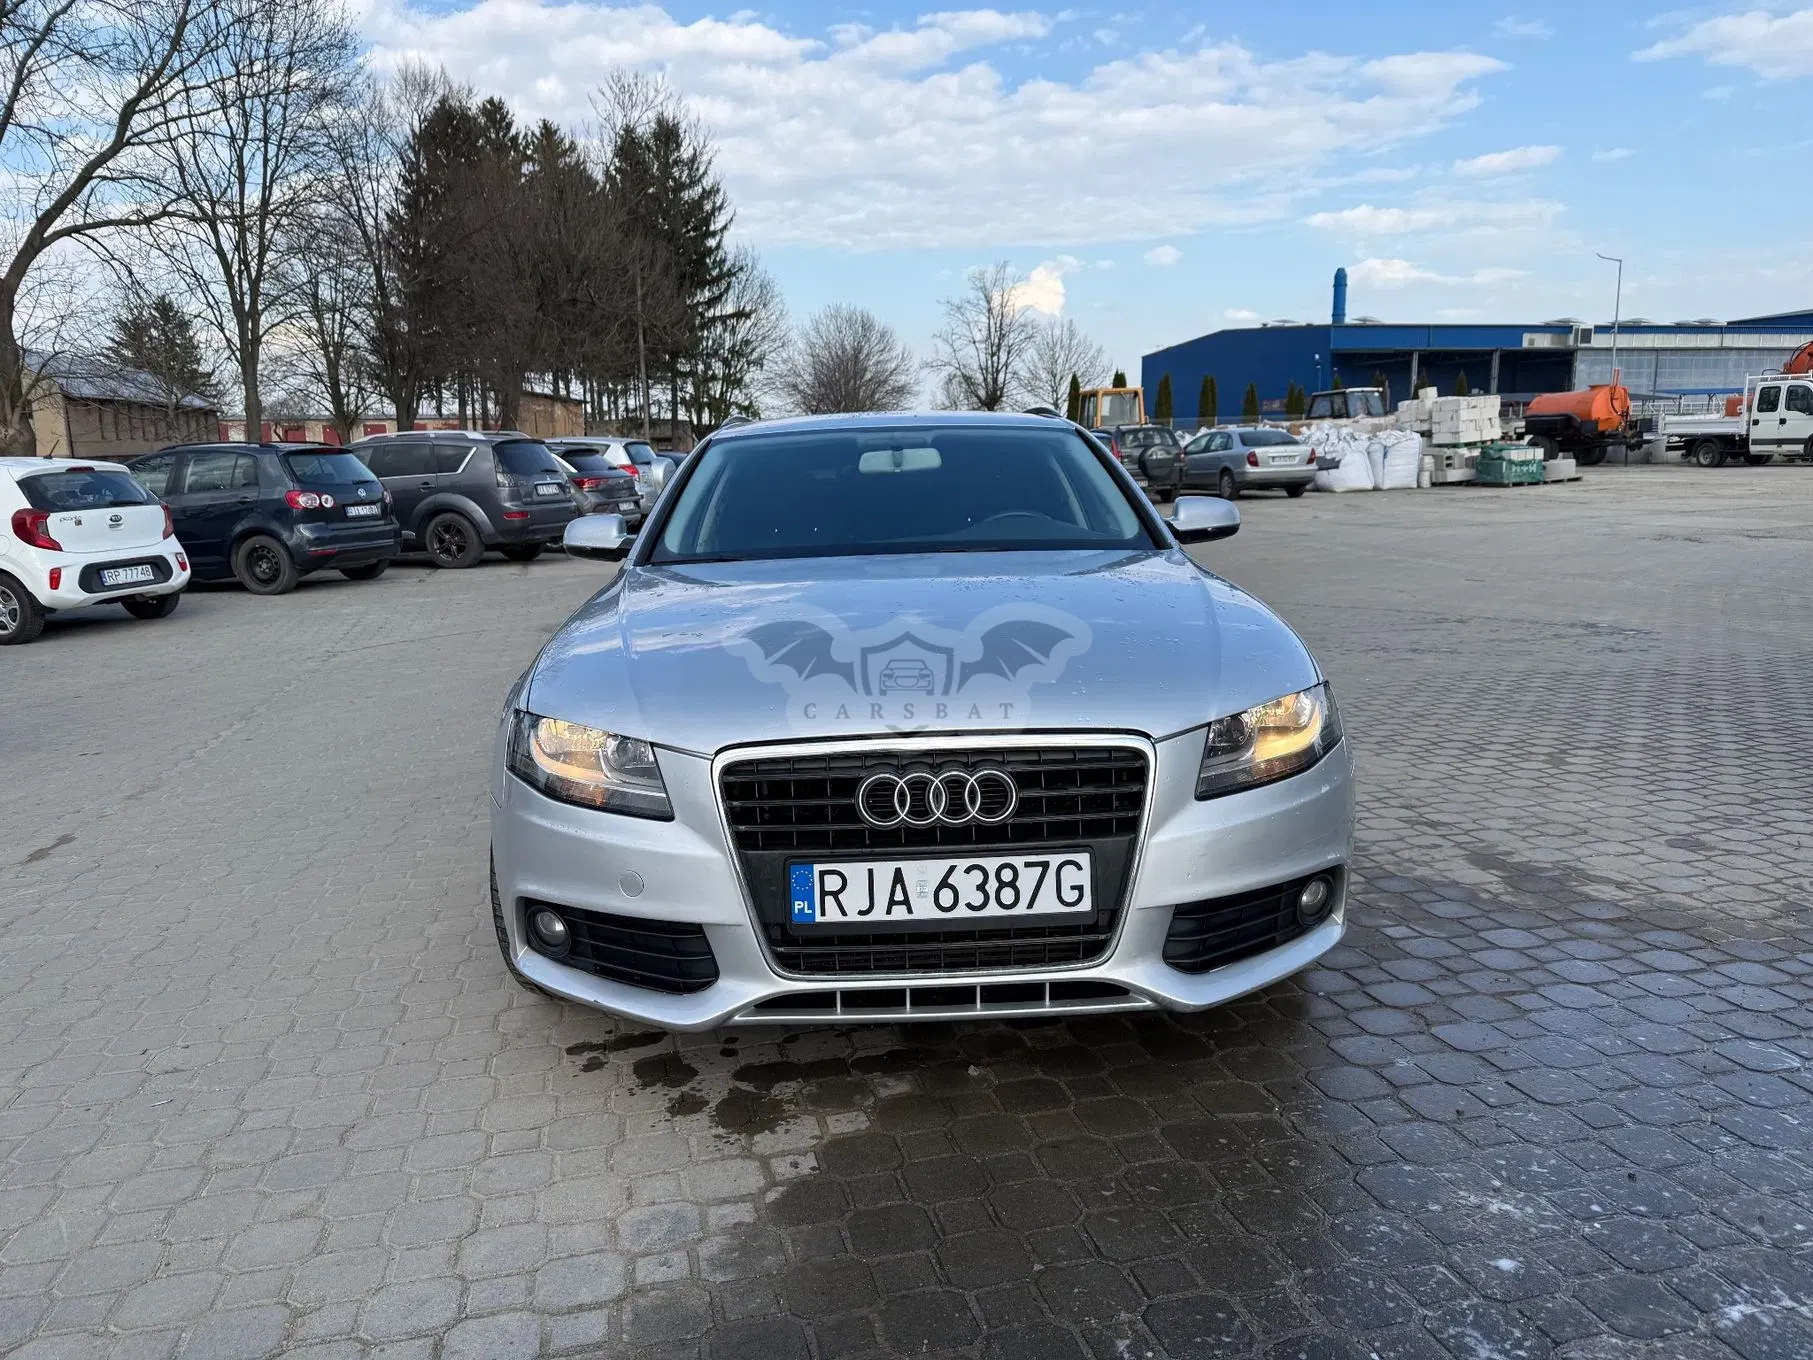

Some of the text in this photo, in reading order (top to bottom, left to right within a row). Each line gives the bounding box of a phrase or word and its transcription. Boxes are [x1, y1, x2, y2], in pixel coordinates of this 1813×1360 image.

[106, 566, 151, 582] RP 77748
[818, 859, 1085, 917] RJA 6387G
[794, 900, 812, 914] PL
